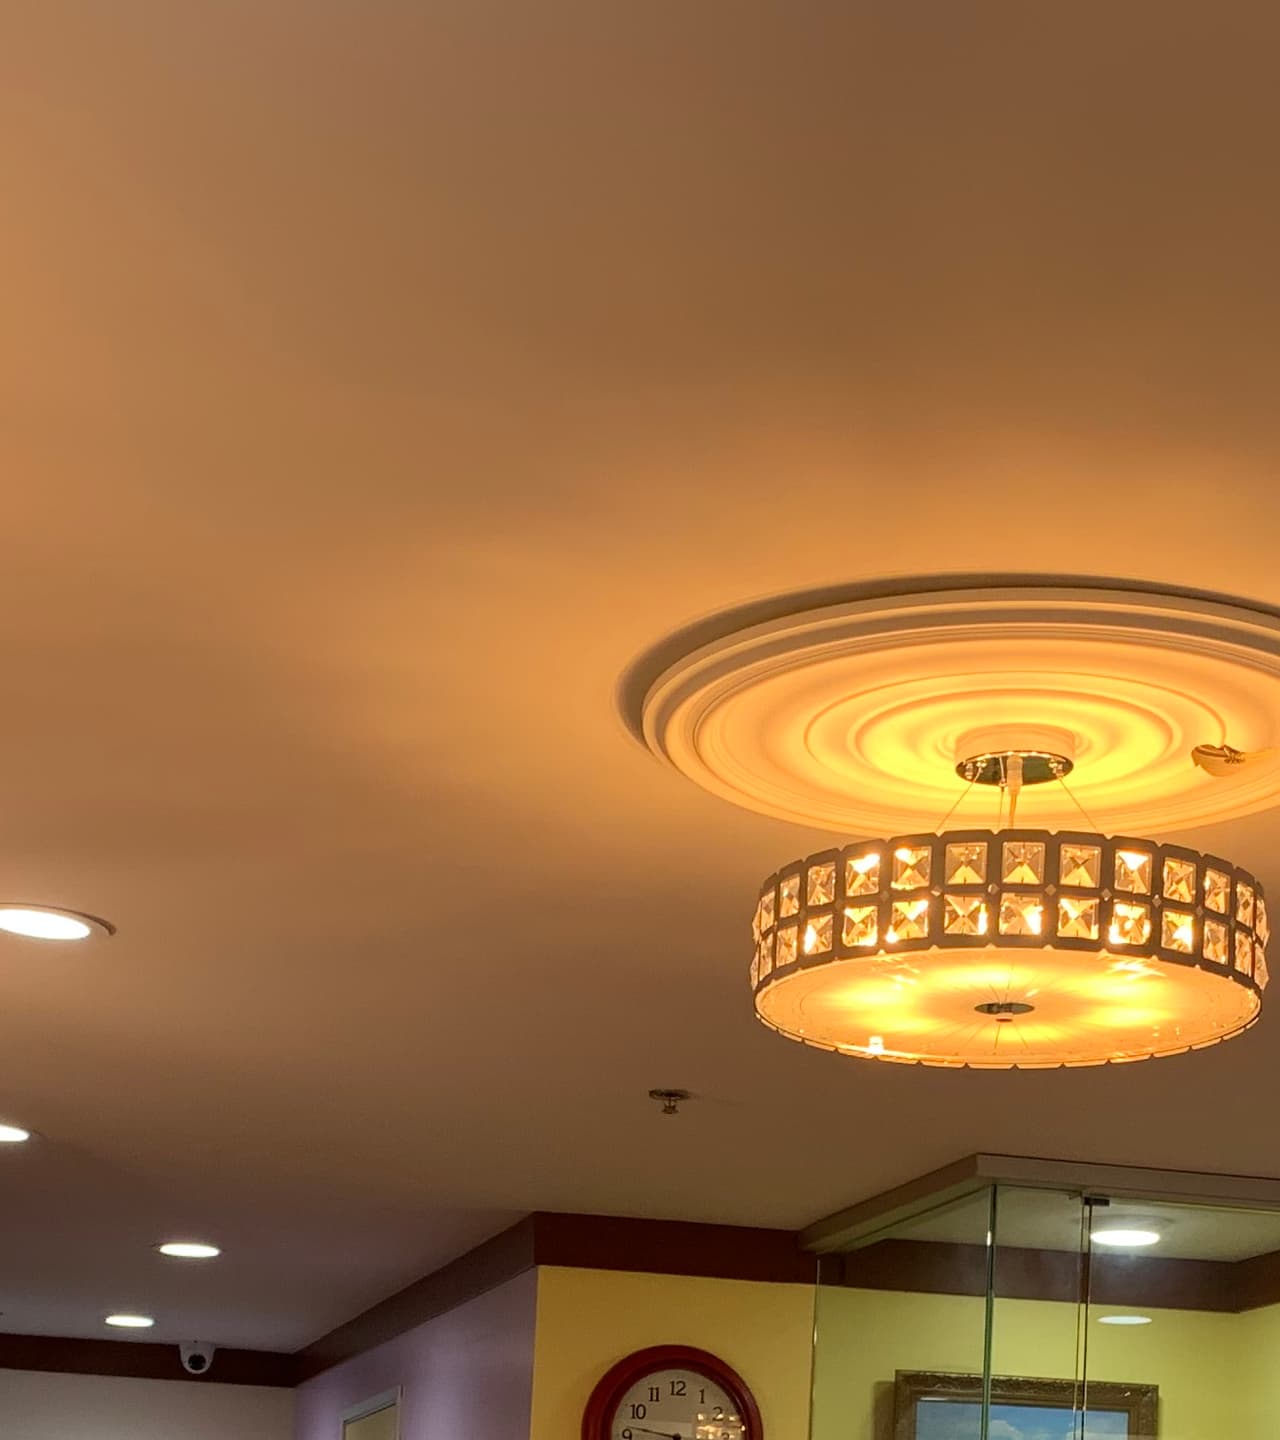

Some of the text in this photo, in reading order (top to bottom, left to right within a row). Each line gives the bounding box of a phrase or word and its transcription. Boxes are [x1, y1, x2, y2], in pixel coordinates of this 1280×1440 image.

[648, 1386, 660, 1402] 11
[669, 1380, 687, 1397] 12
[699, 1388, 705, 1404] 1
[630, 1403, 646, 1420] 10
[712, 1406, 724, 1422] 2
